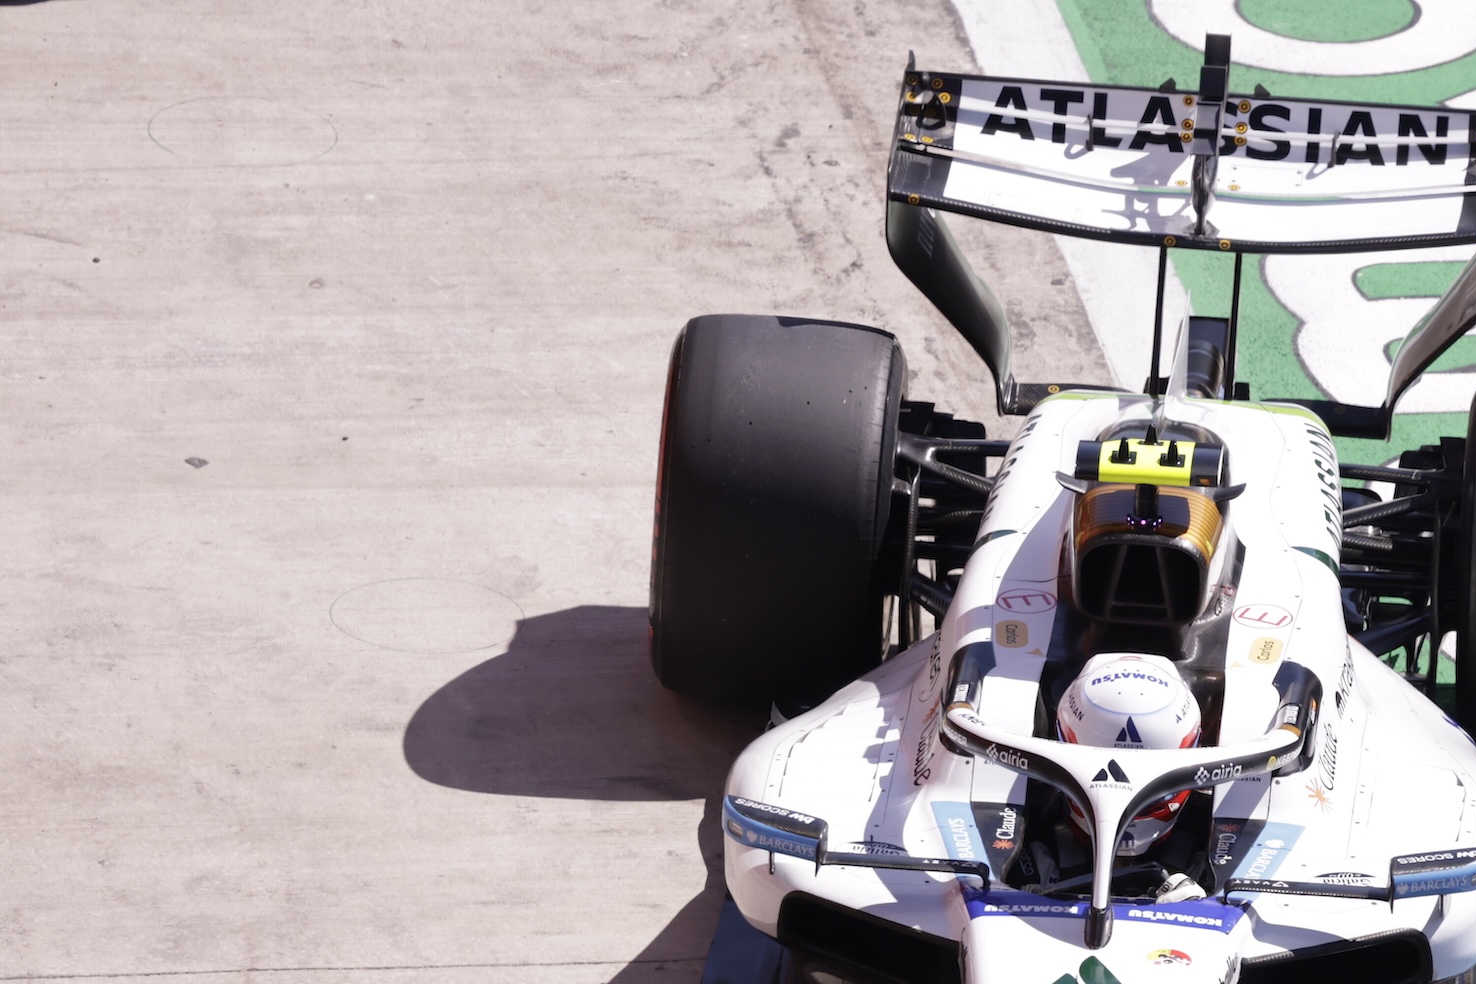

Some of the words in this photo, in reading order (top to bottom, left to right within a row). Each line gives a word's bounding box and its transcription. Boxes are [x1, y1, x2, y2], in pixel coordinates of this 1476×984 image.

[1006, 624, 1020, 645] Carlos
[1257, 641, 1274, 661] Carlos
[1092, 672, 1169, 688] KOMATSU
[1000, 749, 1029, 770] airia
[1317, 721, 1338, 791] Claude
[1211, 762, 1242, 781] airia
[1089, 781, 1133, 792] ATLASSIAN
[735, 798, 790, 816] SCORES
[995, 807, 1017, 839] Claude
[758, 834, 815, 857] BARCLAYS
[1244, 848, 1278, 879] BARCLA
[1396, 853, 1454, 865] SCORES
[1411, 875, 1468, 892] BARCLAYS
[984, 904, 1079, 914] KOMATSU
[1129, 909, 1222, 927] KOMATSU
